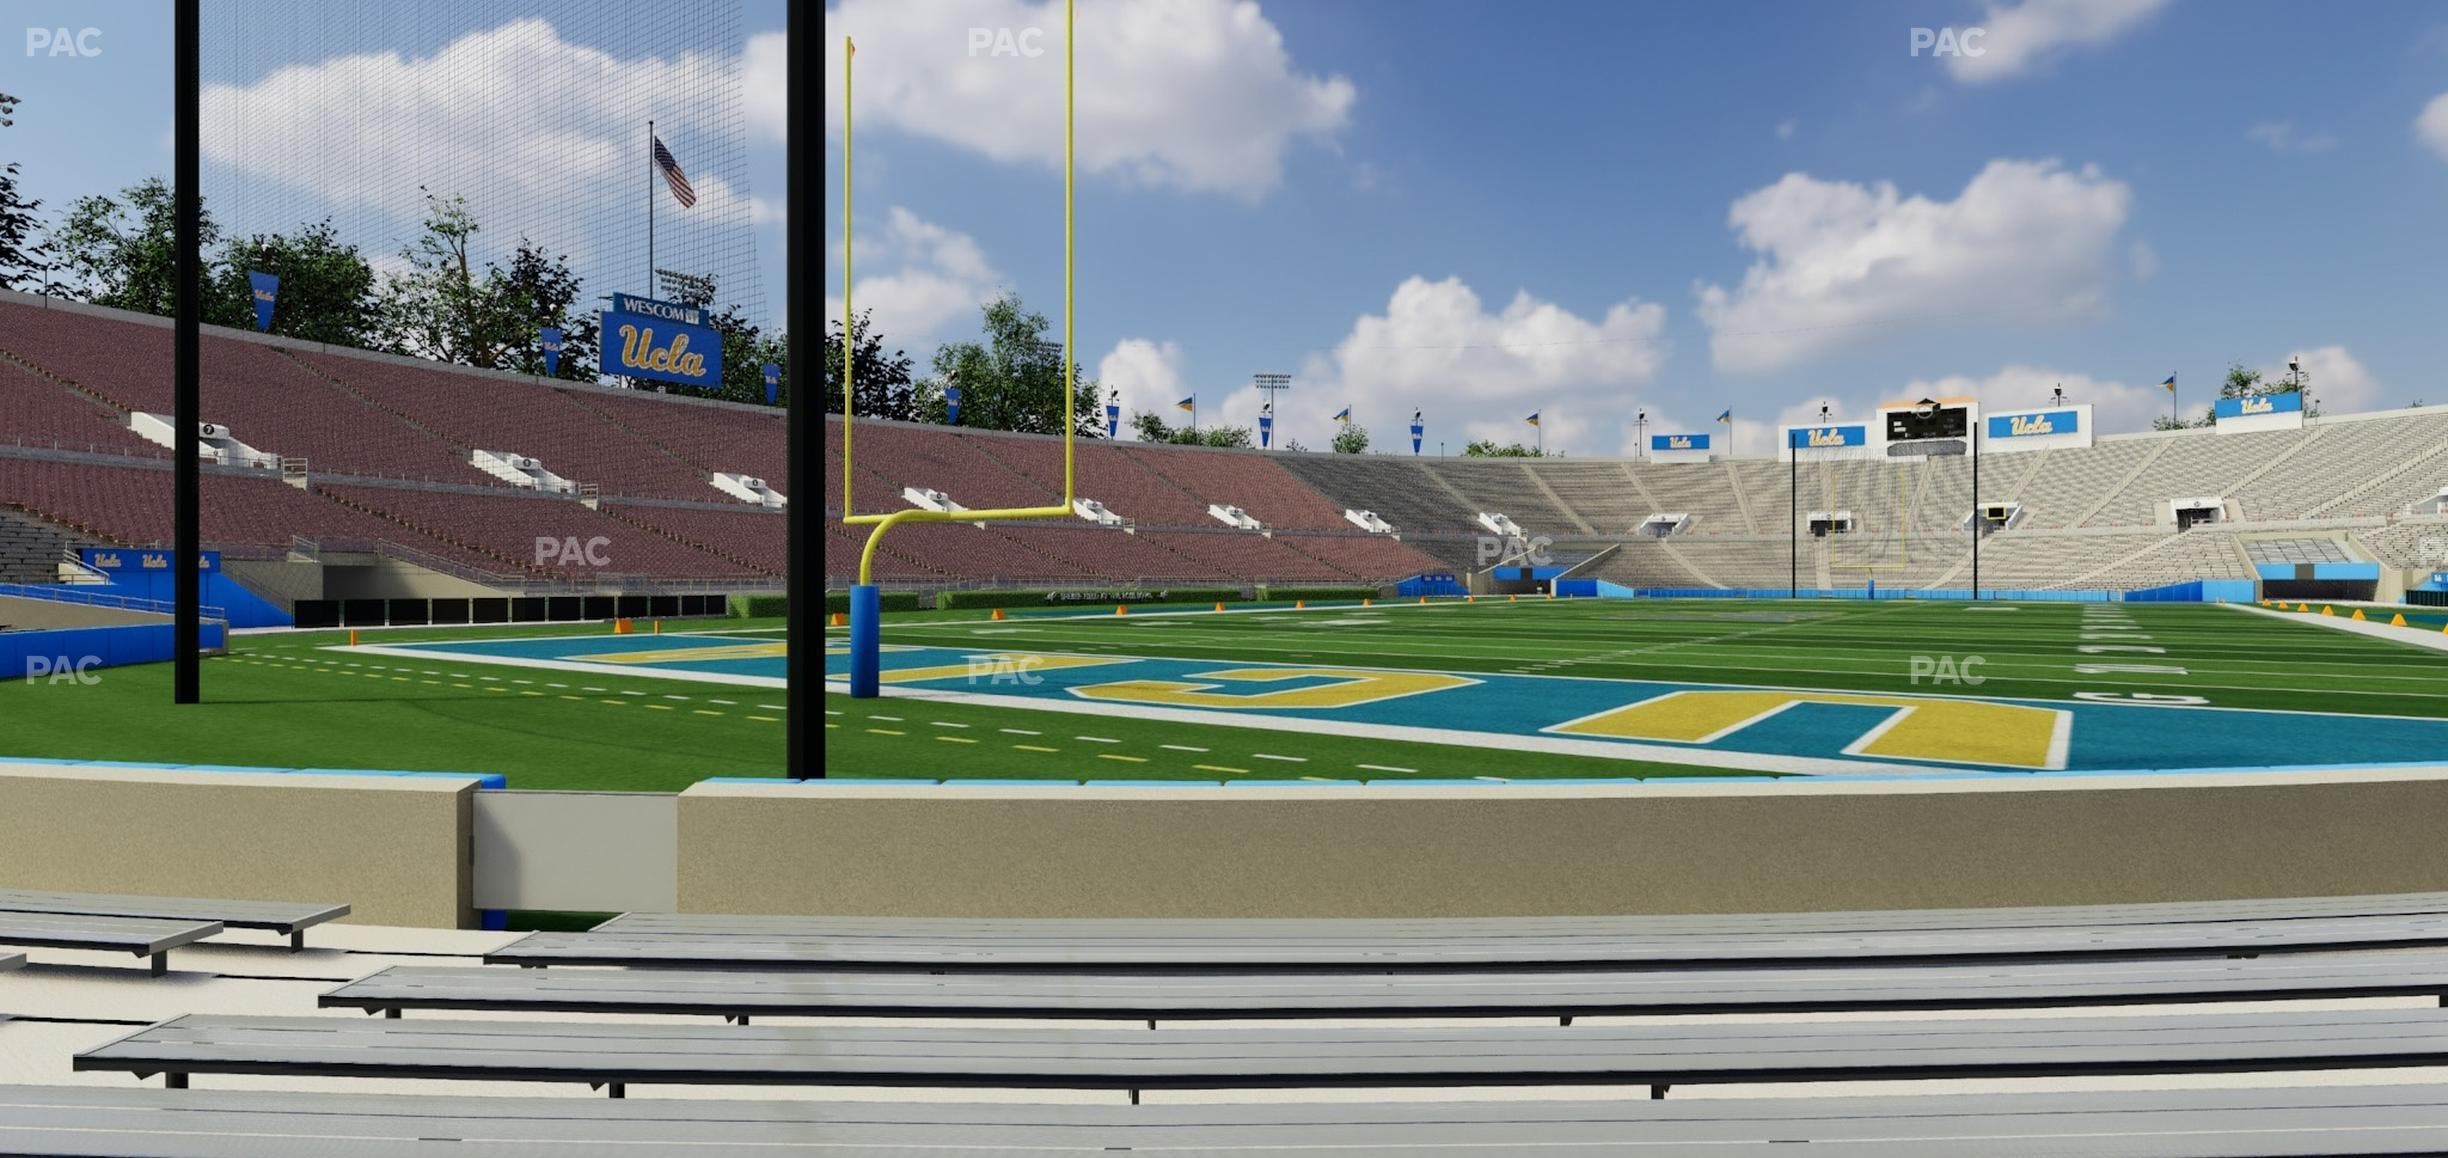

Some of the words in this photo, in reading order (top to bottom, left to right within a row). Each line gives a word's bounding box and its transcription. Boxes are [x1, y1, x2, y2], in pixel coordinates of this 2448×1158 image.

[624, 298, 684, 321] WESCOM
[619, 324, 707, 377] Ucla
[2241, 398, 2273, 414] Ucla
[2011, 415, 2053, 435] Ucla
[1808, 429, 1844, 446] Ucla
